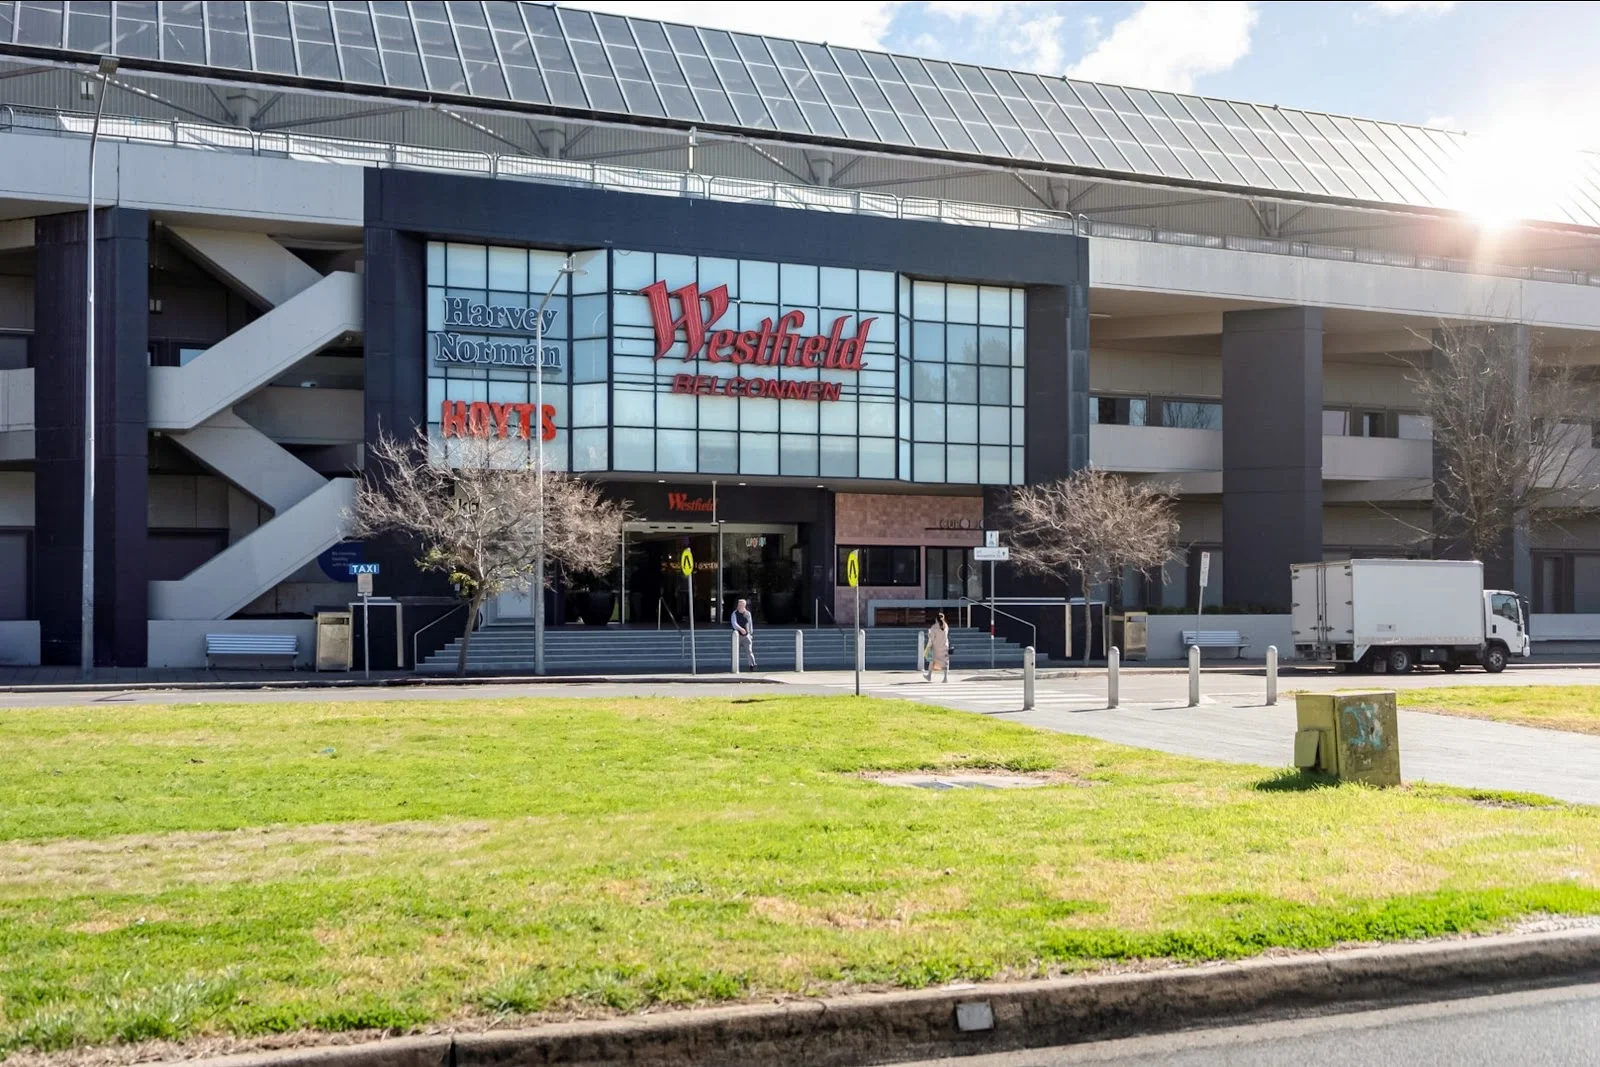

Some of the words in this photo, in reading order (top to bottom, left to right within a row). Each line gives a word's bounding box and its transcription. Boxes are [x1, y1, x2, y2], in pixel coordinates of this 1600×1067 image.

[444, 297, 559, 336] Harvey
[638, 280, 878, 370] Westfield
[435, 332, 561, 367] Norman
[672, 373, 842, 401] BELCONNEN
[442, 400, 557, 441] HOYTS
[351, 564, 377, 573] TAXI
